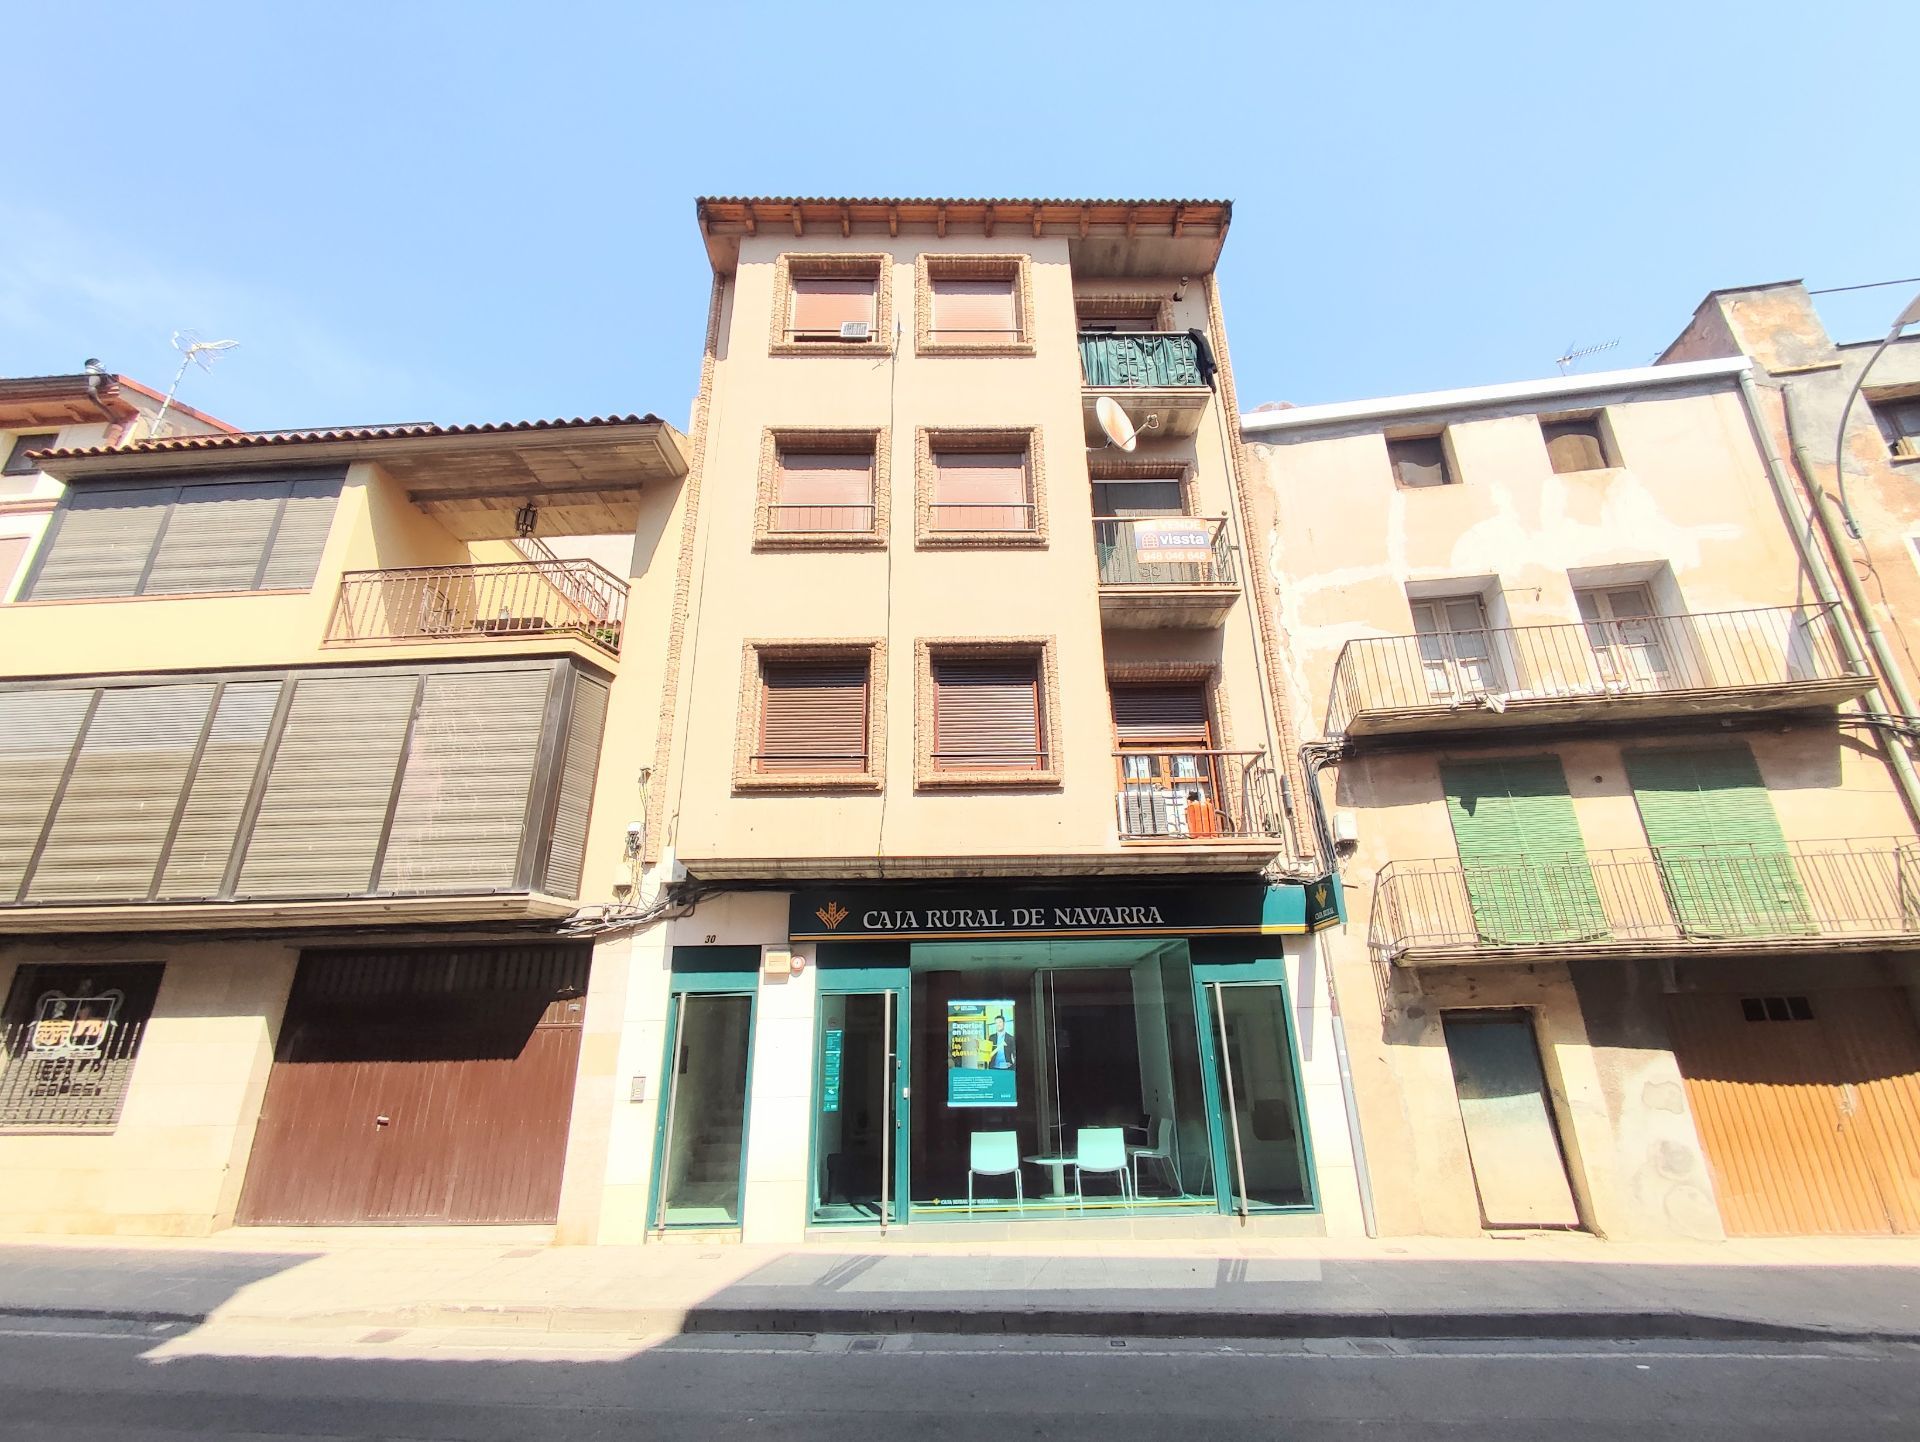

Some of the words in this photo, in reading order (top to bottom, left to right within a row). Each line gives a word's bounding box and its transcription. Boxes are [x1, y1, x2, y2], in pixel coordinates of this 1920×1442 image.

[1159, 533, 1205, 545] vissta
[863, 910, 920, 931] CAJA
[926, 909, 1006, 929] RURAL
[1012, 908, 1045, 927] DE
[1054, 906, 1165, 926] NAVARRA
[704, 934, 717, 944] 30
